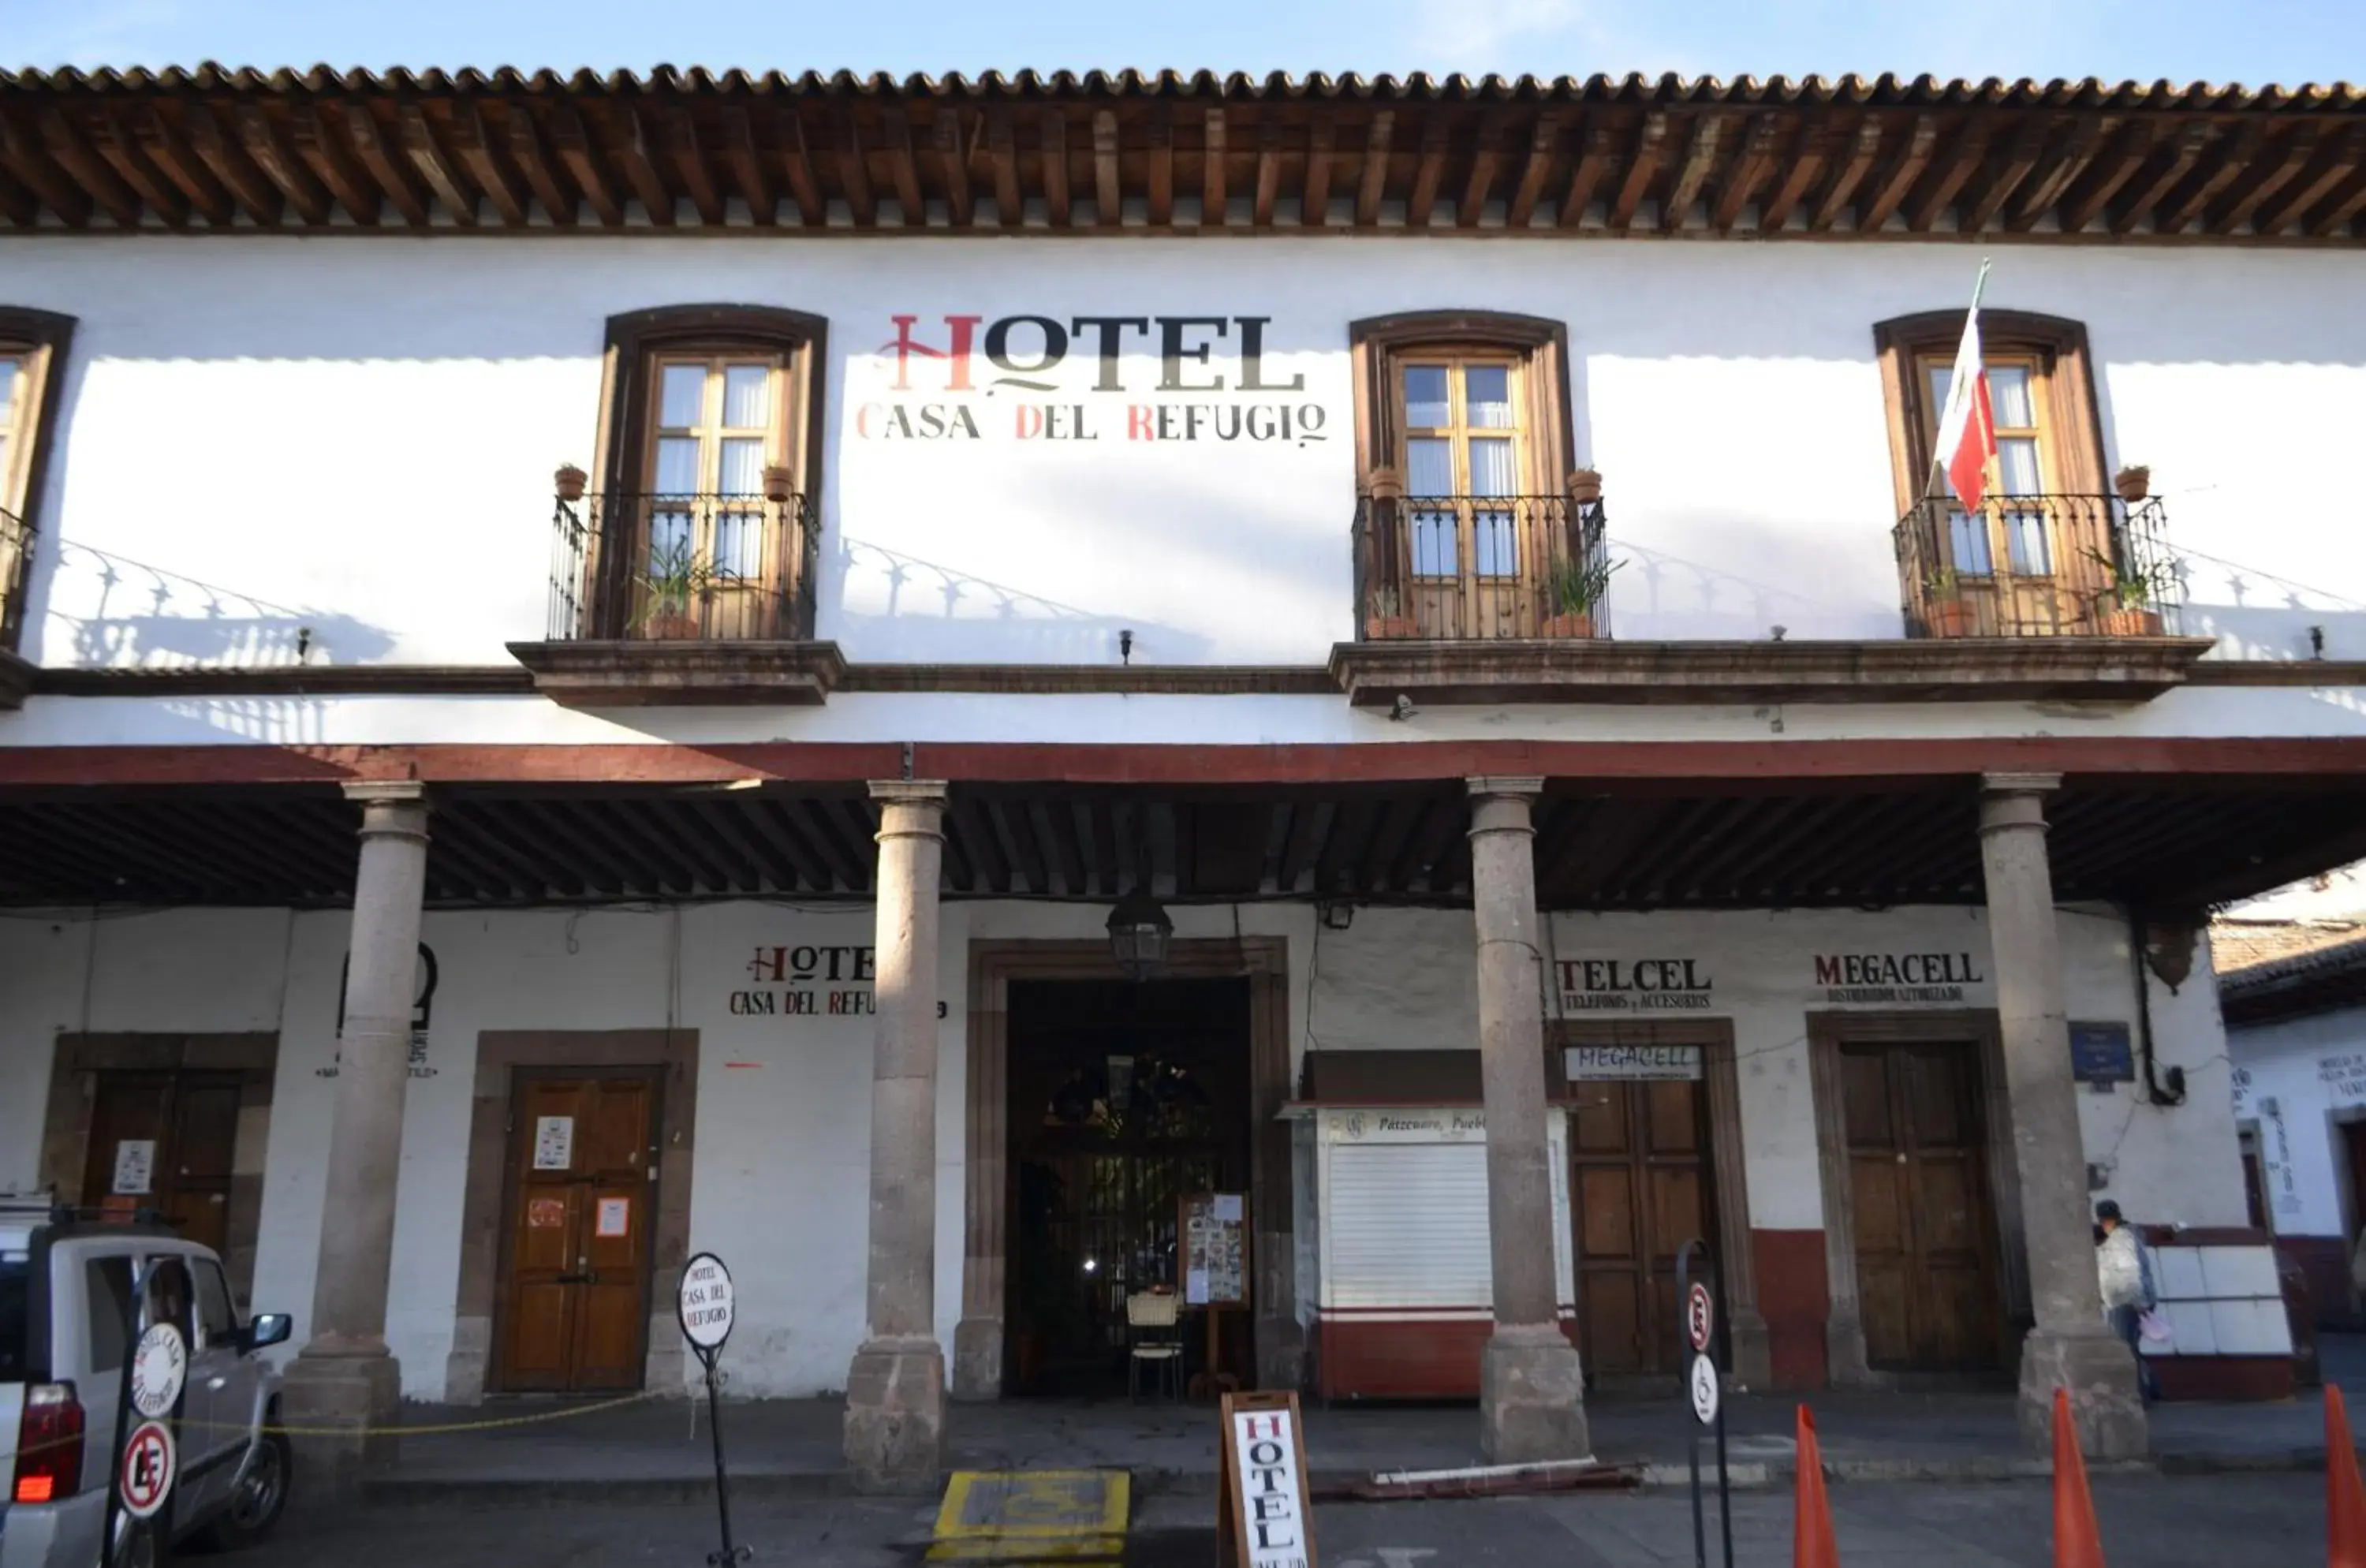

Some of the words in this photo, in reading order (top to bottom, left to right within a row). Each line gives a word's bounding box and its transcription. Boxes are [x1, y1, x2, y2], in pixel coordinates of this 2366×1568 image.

[876, 314, 1304, 397] HOTEL
[856, 403, 981, 440] CASA
[1016, 403, 1098, 440] DEL
[1128, 402, 1328, 447] REFUGIO
[746, 946, 875, 986] HOTE
[1554, 959, 1711, 991] TELCEL
[1813, 952, 1983, 984] MEGACELL
[730, 991, 774, 1014] CASA
[785, 991, 819, 1014] DEL
[829, 991, 876, 1014] REFU
[1454, 1113, 1486, 1130] Puebl
[1245, 1416, 1294, 1550] HOTEL
